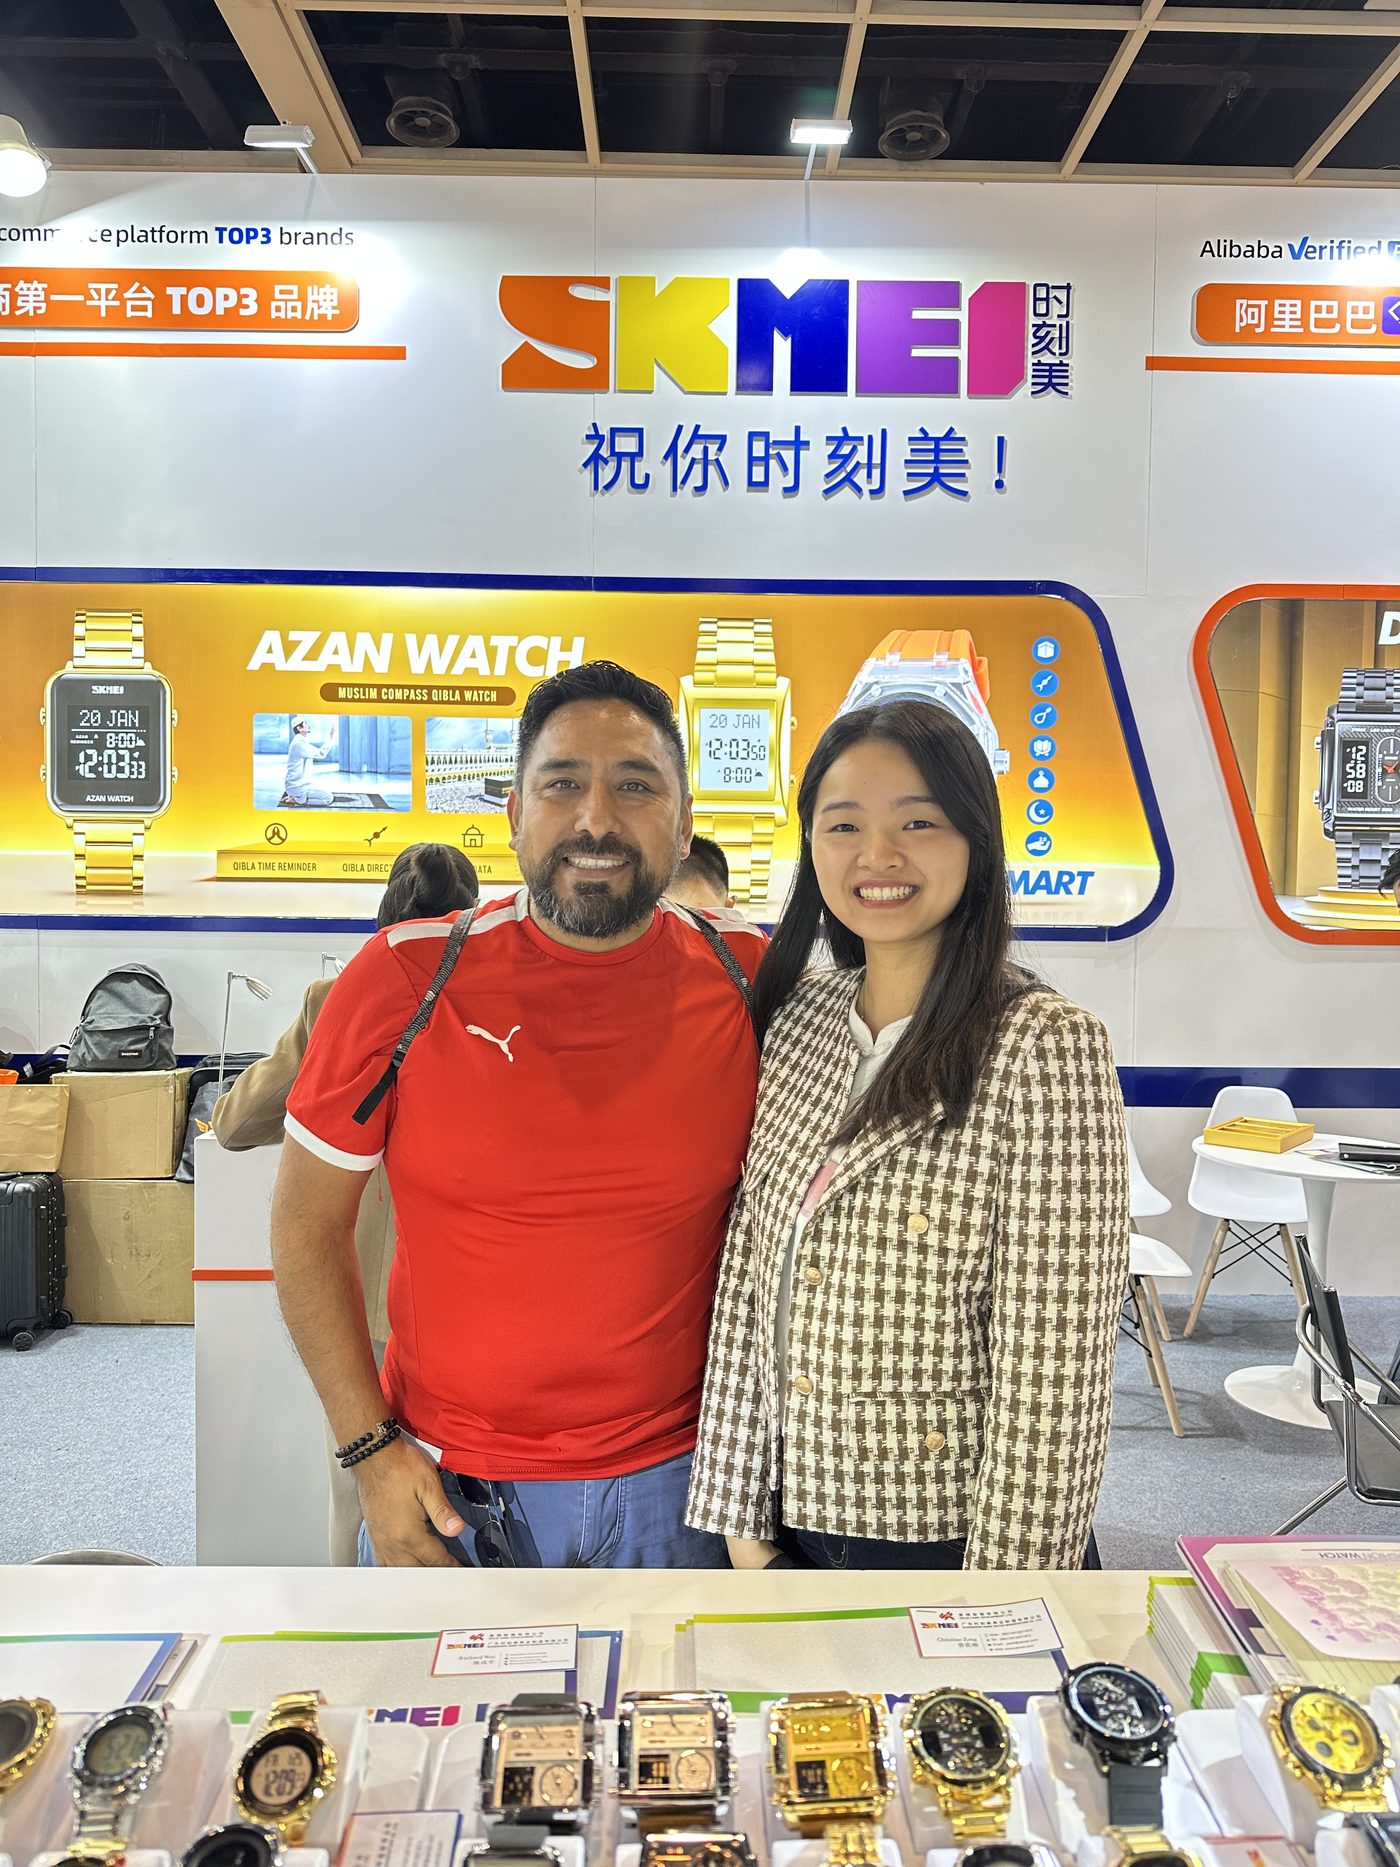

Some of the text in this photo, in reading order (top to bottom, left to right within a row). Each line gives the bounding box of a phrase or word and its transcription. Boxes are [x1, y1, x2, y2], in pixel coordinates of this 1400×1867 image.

[116, 225, 208, 247] platform
[215, 226, 272, 245] TOP3
[279, 227, 354, 246] brands
[1200, 239, 1283, 259] Alibaba
[1287, 236, 1382, 260] Verified
[166, 286, 259, 316] TOP3
[270, 284, 341, 321] 品牌
[1234, 299, 1378, 335] 阿里巴巴
[499, 275, 1028, 398] SKMEI
[1031, 282, 1073, 396] 时刻美
[247, 629, 586, 678] AZAN WATCH
[338, 686, 497, 702] MUSLIM COMPASS QIBLA WATCH
[79, 709, 139, 727] 20 JAN
[709, 713, 760, 729] 20 JAN
[106, 733, 136, 748] 8:00
[709, 738, 750, 761] 12:03
[79, 749, 130, 779] 12:03
[723, 767, 752, 783] 8:00
[233, 861, 317, 872] QIBLA TIME REMINDER
[342, 863, 392, 873] QIBLA DIREC
[1008, 870, 1095, 895] MART
[368, 1705, 461, 1728] MEI
